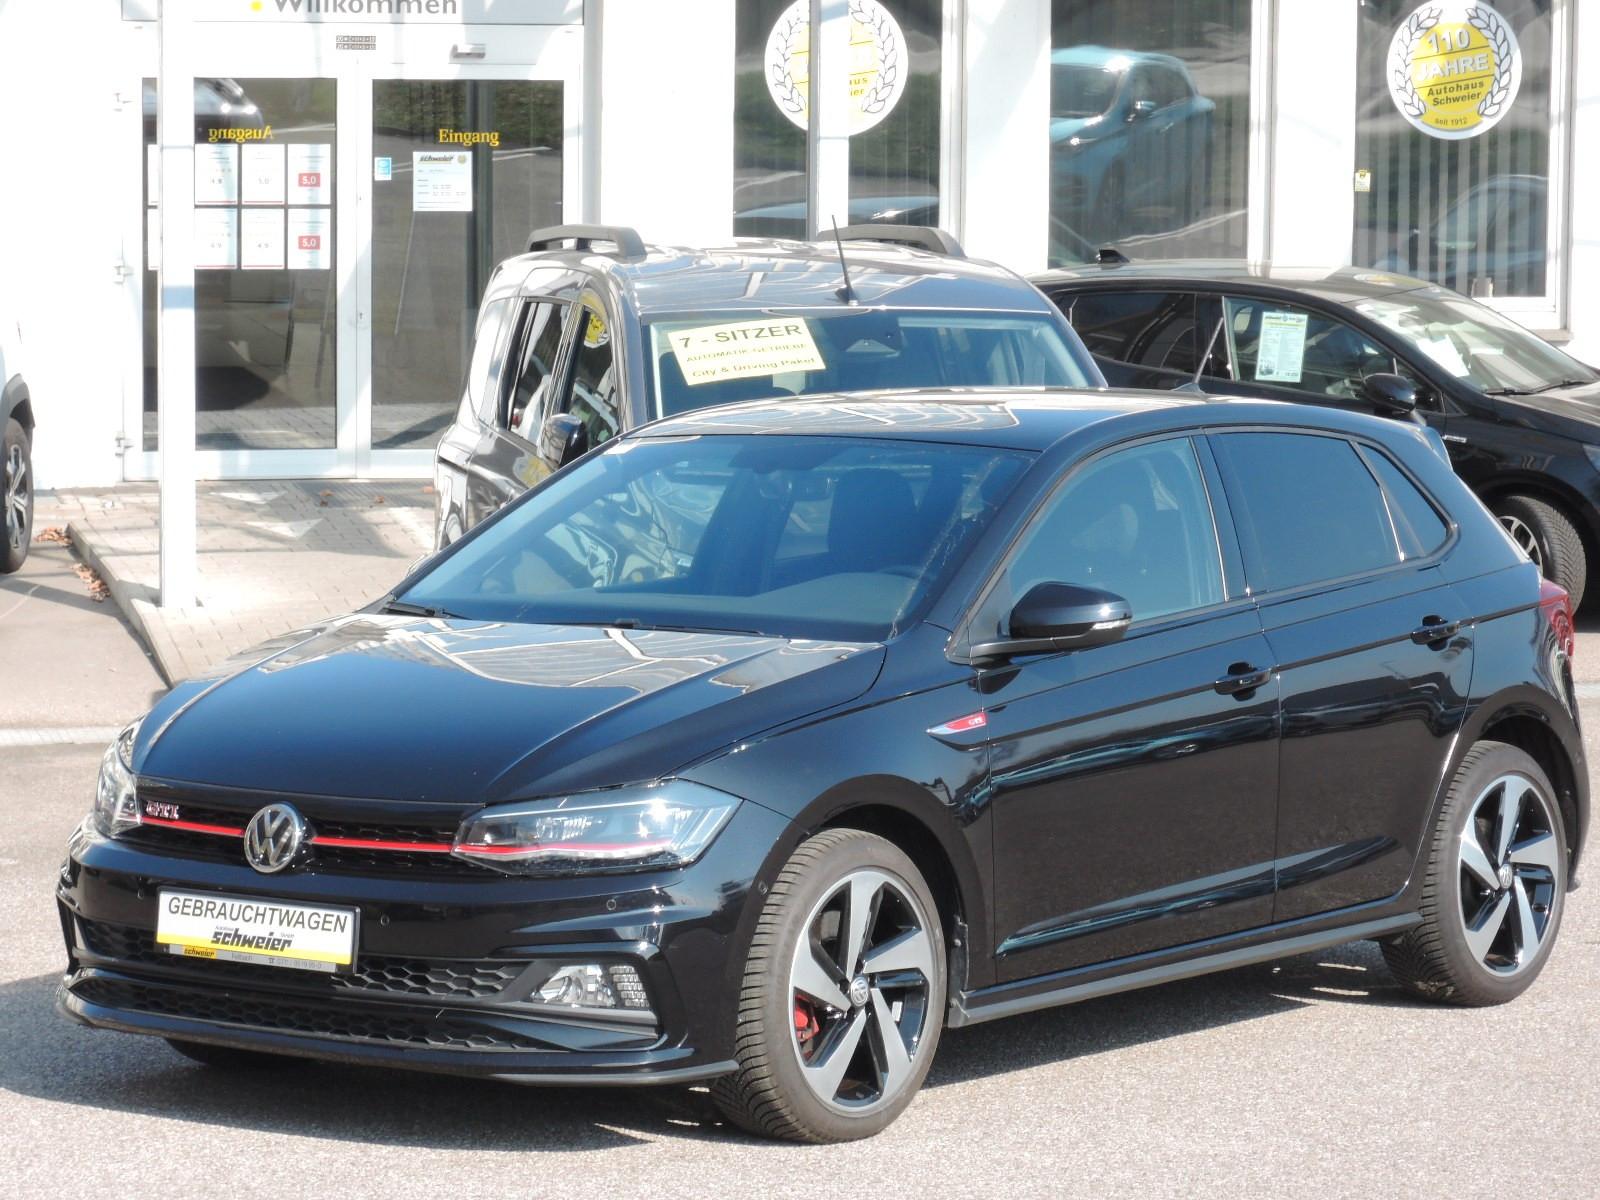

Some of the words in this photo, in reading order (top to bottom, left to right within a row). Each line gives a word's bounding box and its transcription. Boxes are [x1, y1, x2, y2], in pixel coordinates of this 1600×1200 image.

[275, 0, 457, 14] Willkommen
[1429, 28, 1470, 52] 110
[1417, 53, 1489, 80] JAHRE
[1428, 81, 1485, 97] Autohaus
[1432, 91, 1481, 107] Schweier
[438, 128, 499, 147] Eingang
[302, 175, 317, 185] 5.0
[302, 238, 317, 247] 5.0
[679, 337, 691, 348] 7
[715, 324, 803, 343] SITZER
[692, 366, 716, 377] City
[168, 896, 348, 933] GEBRAUCHTWAGEN
[211, 927, 293, 952] schweier
[184, 947, 215, 958] schweier
